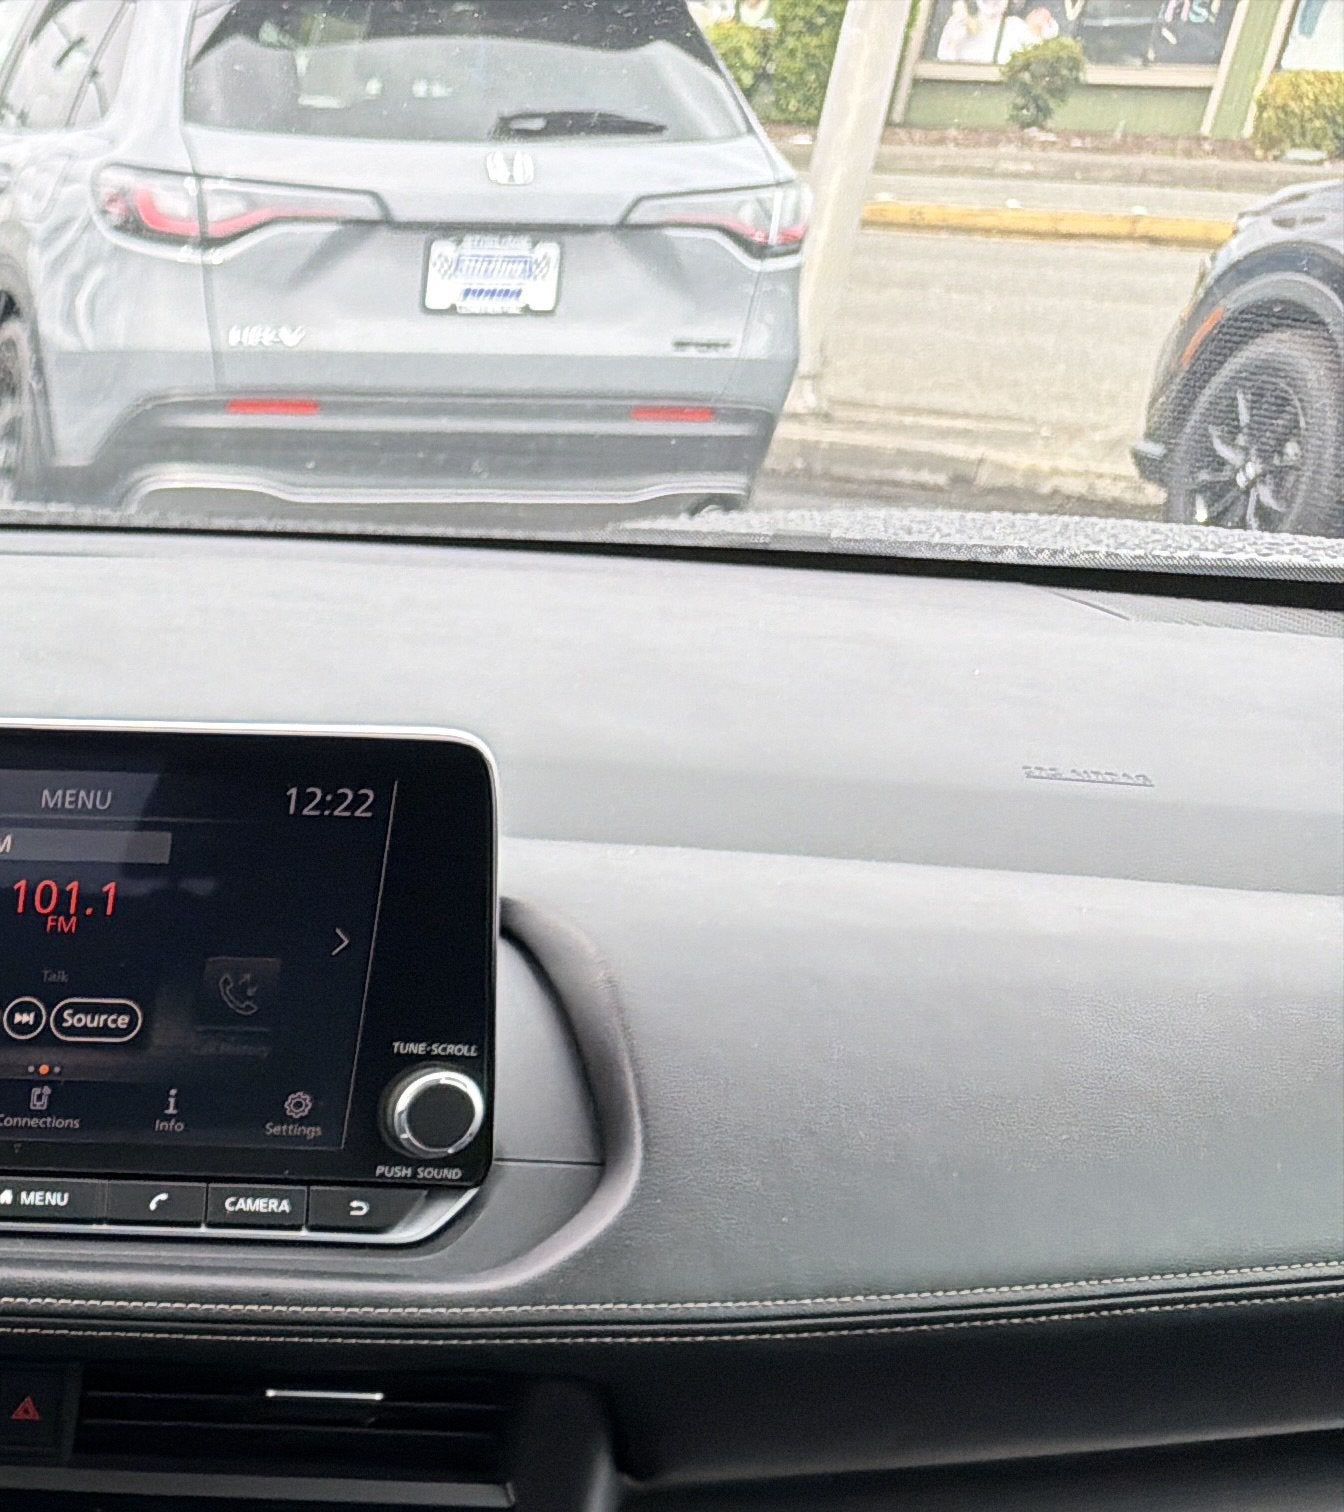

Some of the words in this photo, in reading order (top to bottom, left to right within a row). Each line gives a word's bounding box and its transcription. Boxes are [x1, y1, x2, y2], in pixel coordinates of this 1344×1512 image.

[40, 788, 112, 811] MENU
[284, 785, 376, 818] 12:22
[13, 879, 118, 916] 101.1
[46, 915, 77, 934] FM
[61, 1008, 130, 1029] Source
[154, 1118, 185, 1133] Info
[265, 1121, 323, 1140] Settings
[375, 1164, 411, 1178] PUSH
[416, 1166, 462, 1180] SOUND
[20, 1190, 70, 1207] MENU
[224, 1196, 291, 1214] CAMERA
